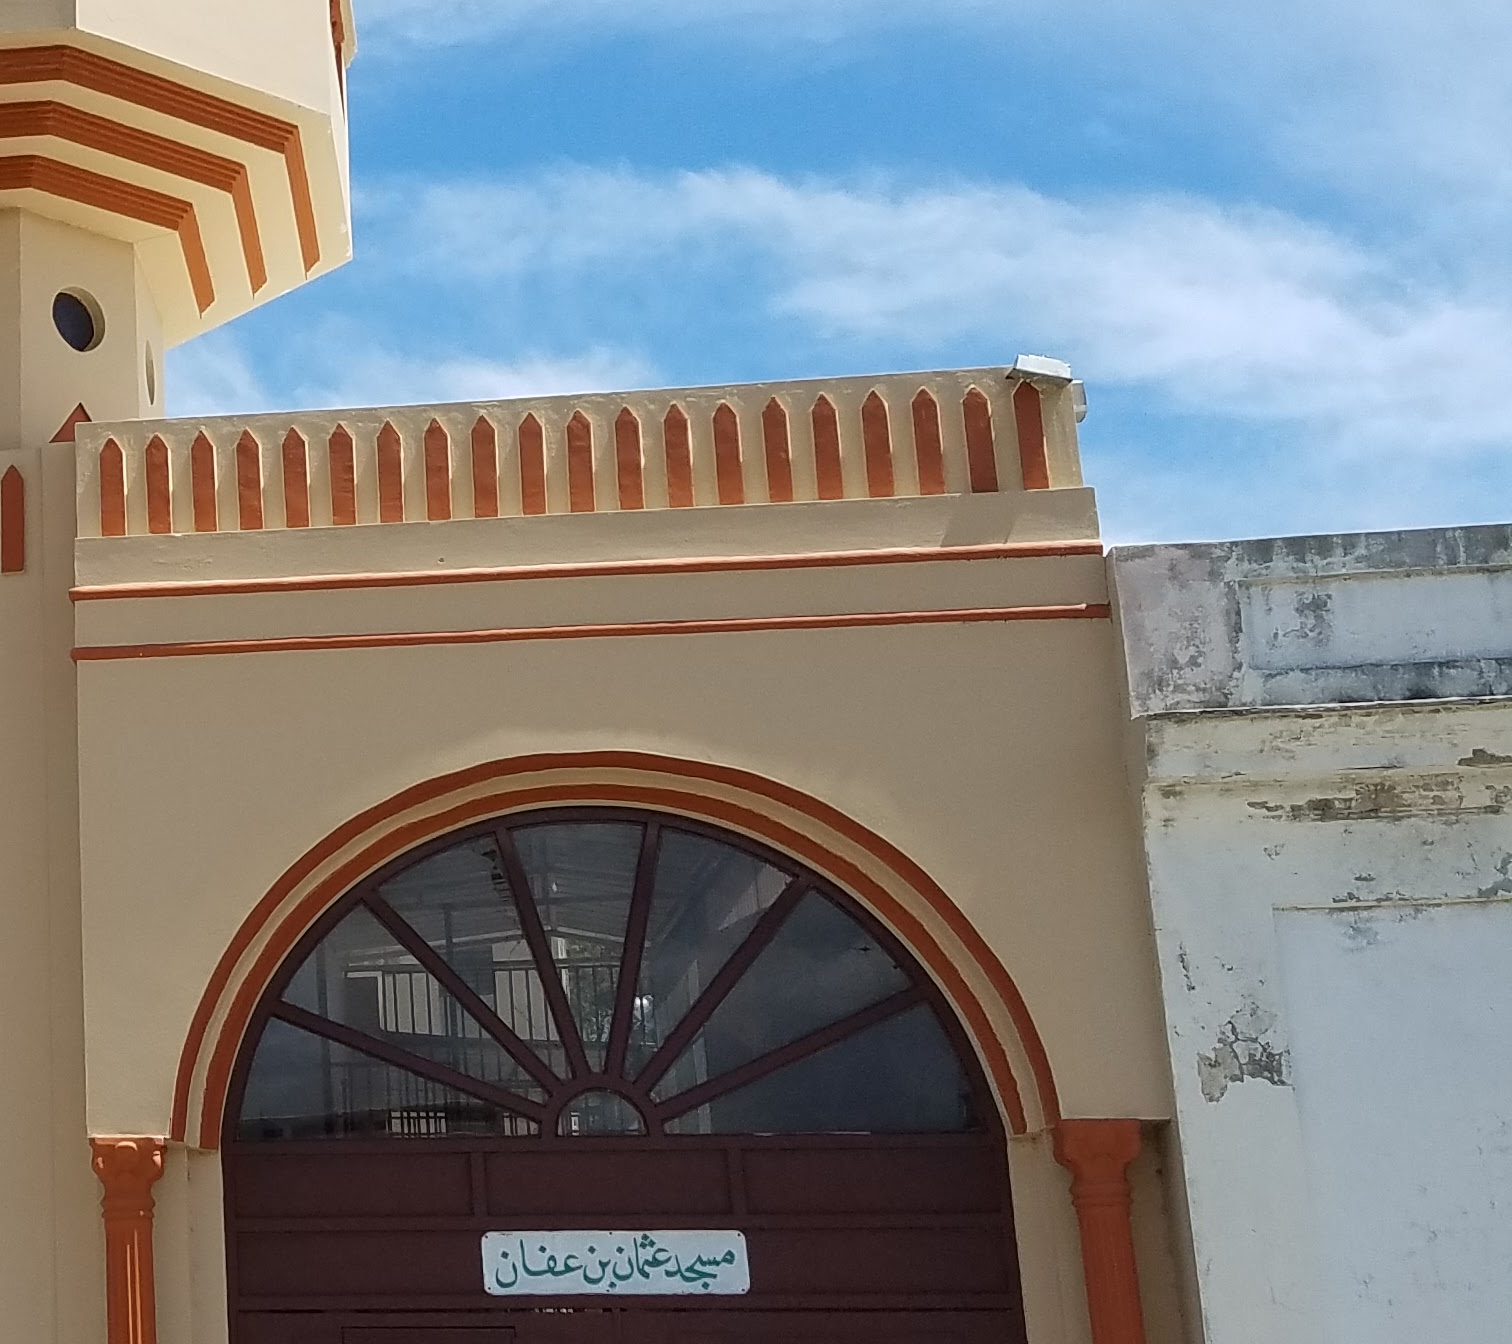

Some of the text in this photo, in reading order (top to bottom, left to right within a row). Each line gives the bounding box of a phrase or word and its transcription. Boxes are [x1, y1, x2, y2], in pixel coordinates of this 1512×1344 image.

[495, 1234, 737, 1291] مسجد عثمان بن عفان
